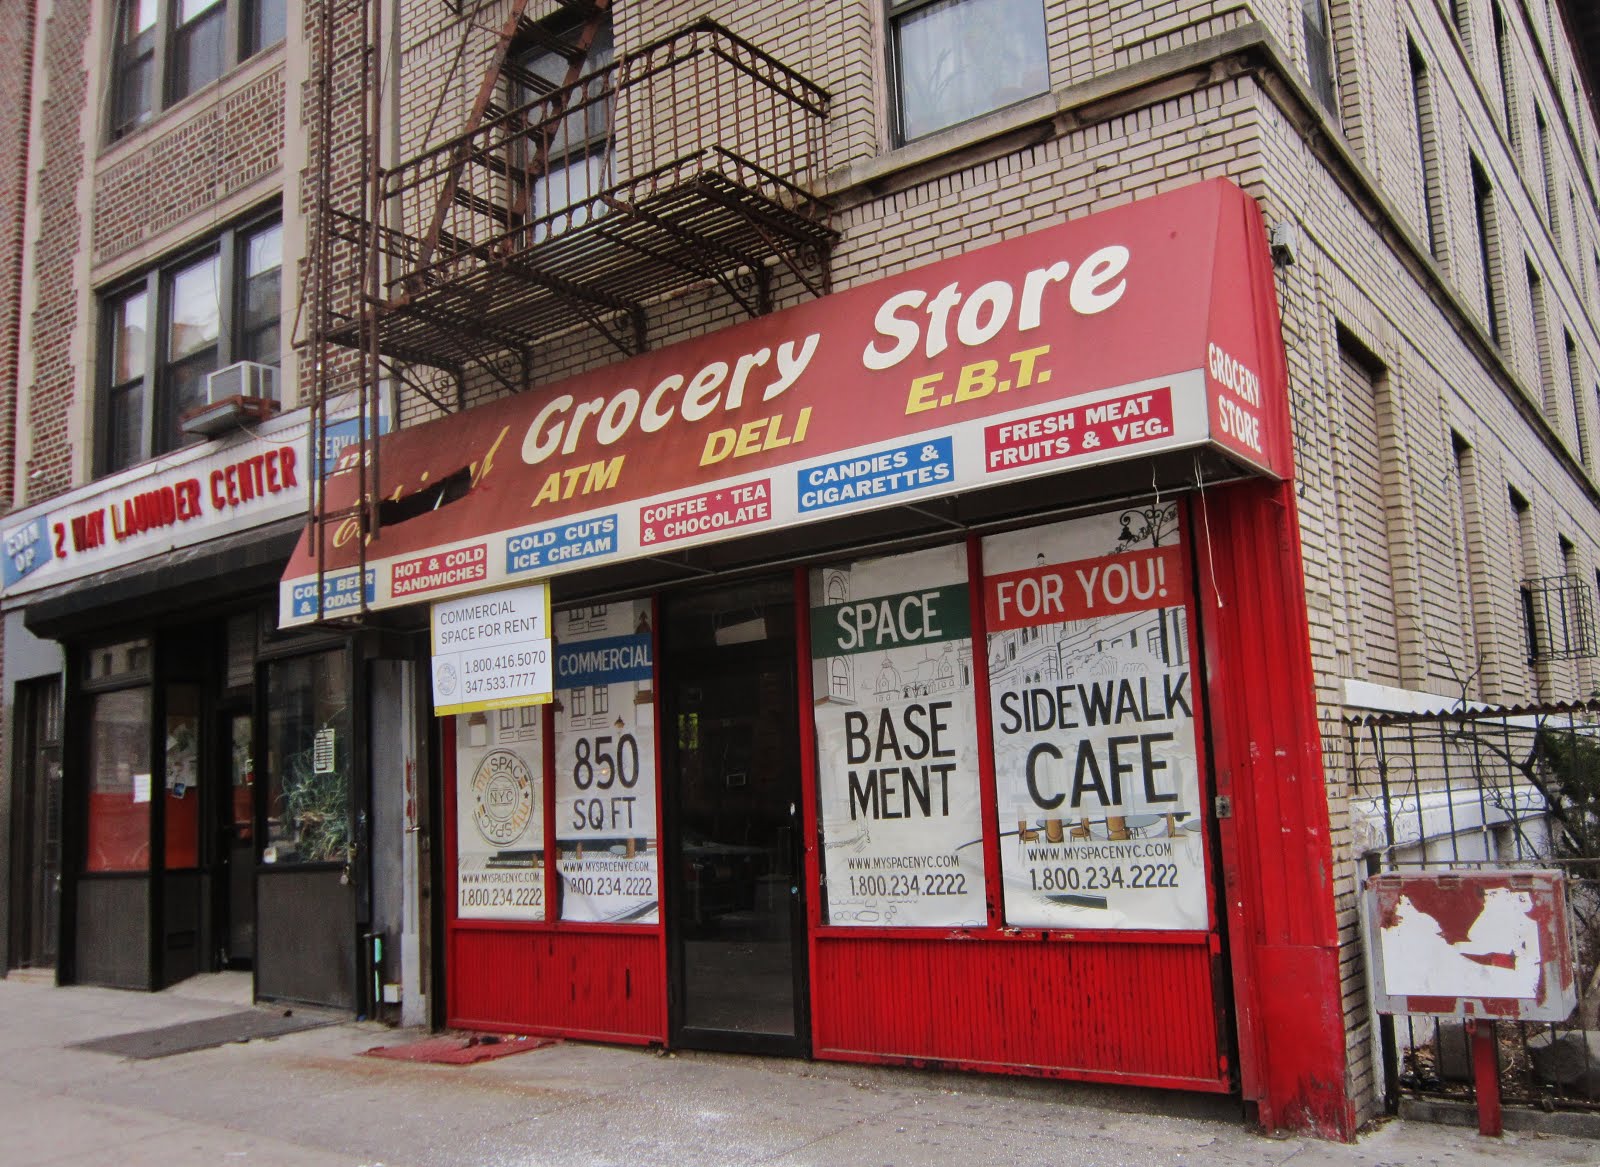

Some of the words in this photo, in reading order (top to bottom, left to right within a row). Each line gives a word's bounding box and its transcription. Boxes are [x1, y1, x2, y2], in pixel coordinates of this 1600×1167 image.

[521, 333, 821, 465] Grocery
[862, 245, 1130, 370] Store
[1208, 342, 1260, 408] GROCERY
[905, 345, 1052, 416] E.B.T.
[999, 411, 1075, 445] FRESH
[1085, 395, 1153, 426] MEAT
[1219, 394, 1262, 453] STORE
[315, 433, 371, 460] SERV
[531, 455, 626, 507] ATM
[699, 406, 813, 466] DELI
[990, 439, 1071, 469] FRUITS
[1081, 431, 1101, 450] &
[1111, 419, 1170, 443] VEG.
[801, 462, 951, 508] CIGARETTES
[808, 451, 909, 486] CANDIES
[919, 444, 940, 462] &
[53, 522, 67, 559] 2
[71, 508, 105, 553] WAY
[111, 478, 203, 542] LAUNDER
[210, 446, 298, 511] CENTER
[644, 497, 708, 524] COFFEE
[731, 484, 767, 502] TEA
[508, 532, 557, 553] COLD
[564, 518, 615, 541] CUTS
[643, 527, 656, 543] &
[663, 503, 769, 538] CHOCOLATE
[394, 562, 422, 579] HOT
[427, 557, 440, 572] &
[445, 547, 485, 568] COLD
[513, 555, 540, 570] ICE
[548, 537, 612, 562] CREAM
[393, 563, 486, 595] SANDWICHES
[997, 574, 1064, 621] FOR
[1075, 558, 1168, 608] YOU!
[301, 601, 311, 614] &
[318, 591, 361, 609] ODAS
[440, 600, 516, 626] COMMERCIAL
[836, 592, 942, 650] SPACE
[441, 627, 475, 645] SPACE
[478, 623, 502, 639] FOR
[504, 616, 538, 634] RENT
[465, 650, 546, 674] 1.800.416.5070
[558, 644, 653, 677] COMMERCIAL
[465, 672, 536, 694] 347.533.7777
[1000, 671, 1193, 735] SIDEWALK
[844, 701, 956, 764] BASE
[573, 733, 639, 790] 850
[1026, 732, 1179, 810] CAFE
[490, 790, 514, 803] NYC
[848, 763, 957, 821] MENT
[573, 798, 604, 831] SQ
[611, 797, 637, 829] FT
[848, 855, 960, 870] WWW.MYSPACENYC.COM
[1027, 842, 1172, 862] WWW.MYSPACENYC.COM
[461, 887, 542, 906] 1.800.234.2222
[849, 873, 968, 897] 1.800.234.2222
[1029, 863, 1179, 891] 1.800.234.2222
